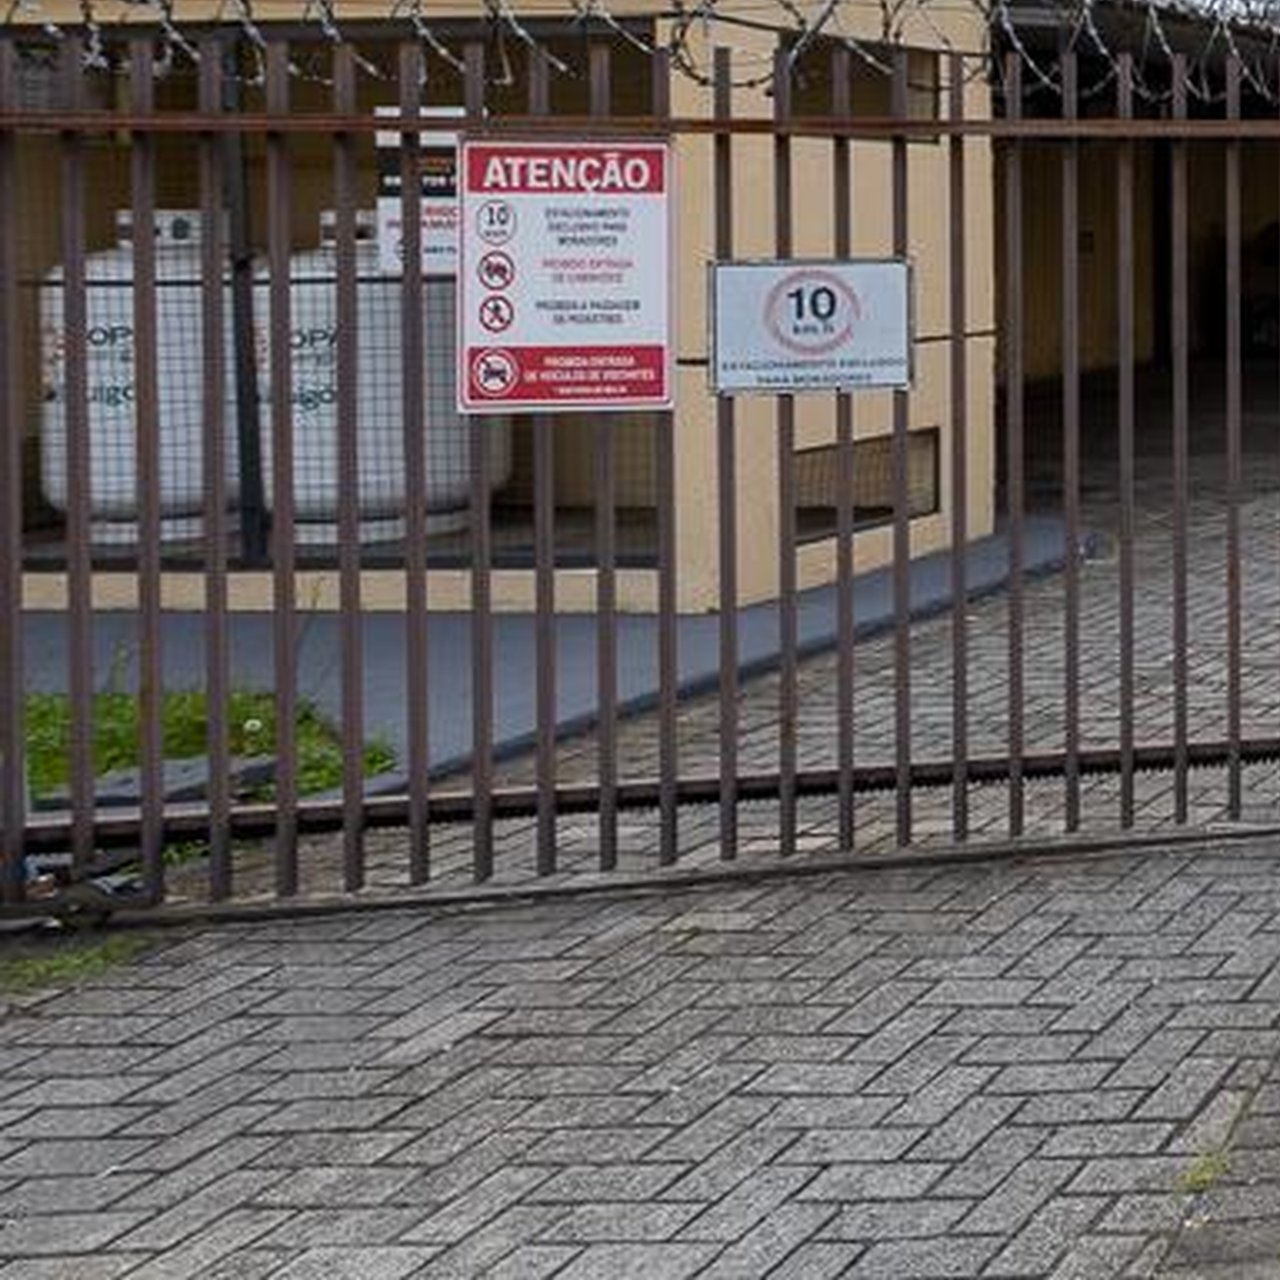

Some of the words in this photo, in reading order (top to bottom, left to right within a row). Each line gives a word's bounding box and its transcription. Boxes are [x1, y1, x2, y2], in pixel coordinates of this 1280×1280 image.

[483, 152, 650, 191] ATENÇÃO
[486, 206, 509, 226] 10
[787, 286, 836, 320] 10
